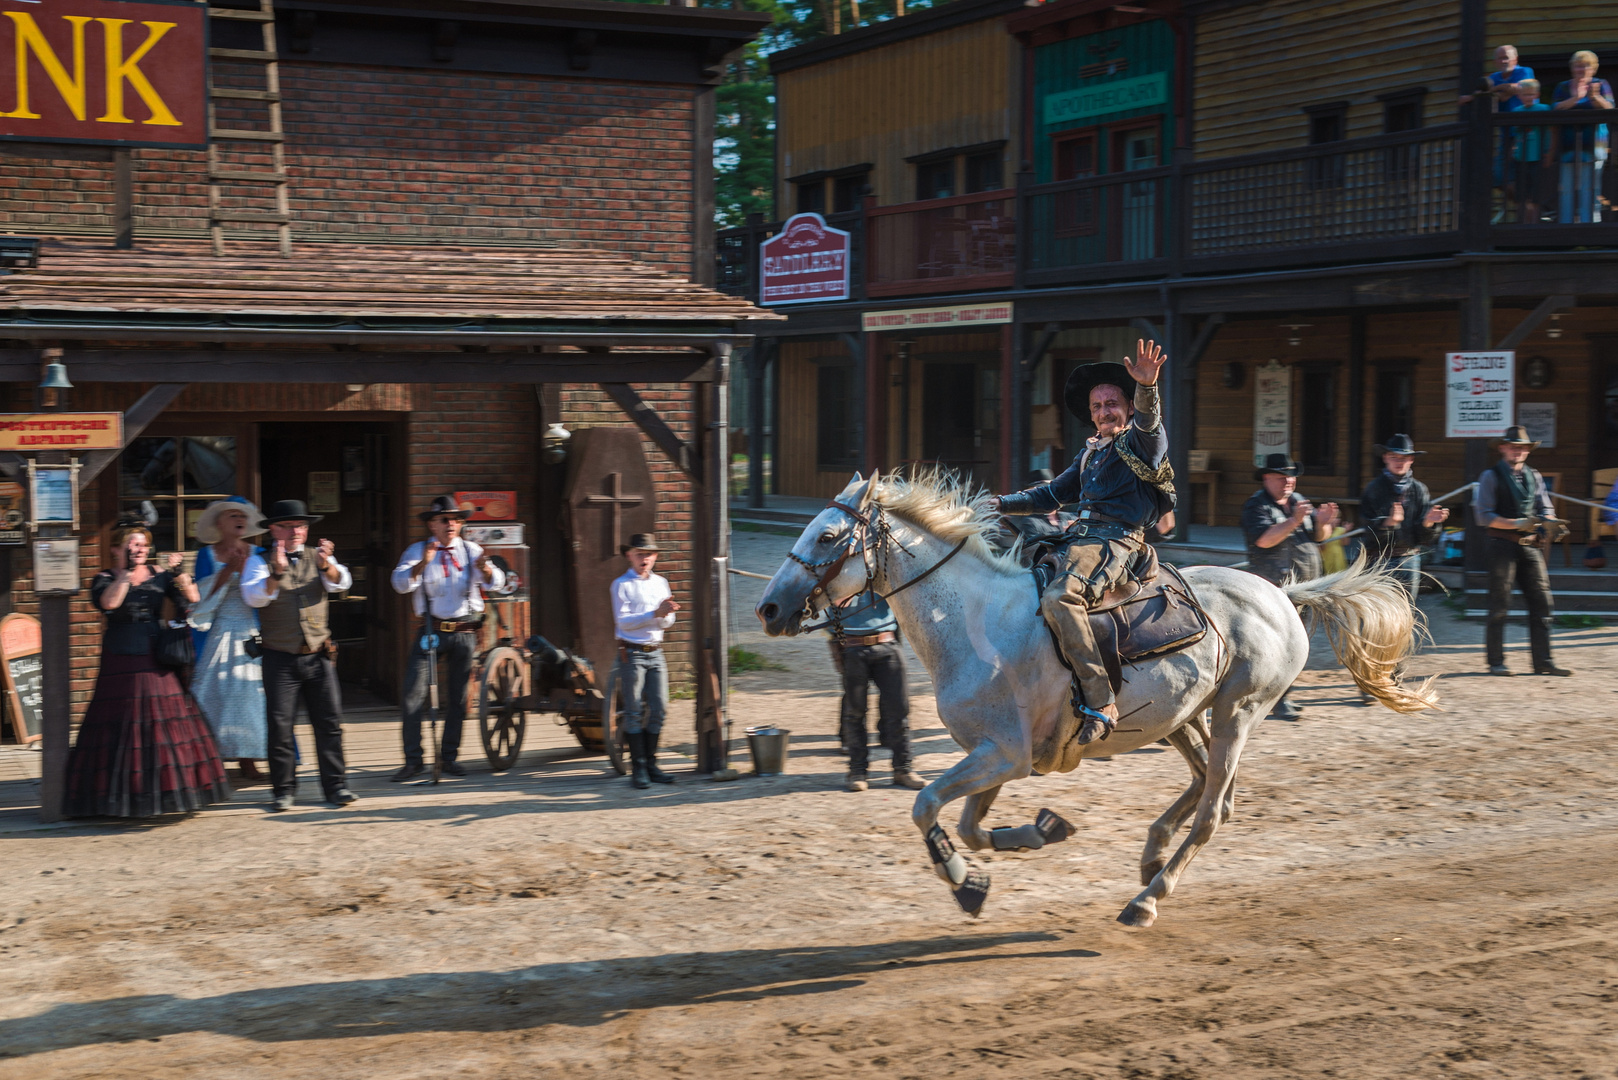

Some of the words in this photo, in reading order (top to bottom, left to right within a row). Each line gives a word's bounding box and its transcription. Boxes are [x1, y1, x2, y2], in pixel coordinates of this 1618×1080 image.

[0, 11, 183, 126] NK
[1050, 81, 1161, 116] APOTHECARY
[764, 250, 846, 277] SADDLERY
[0, 420, 110, 431] POSTKUTSCHE
[17, 434, 89, 445] ABFAHRT
